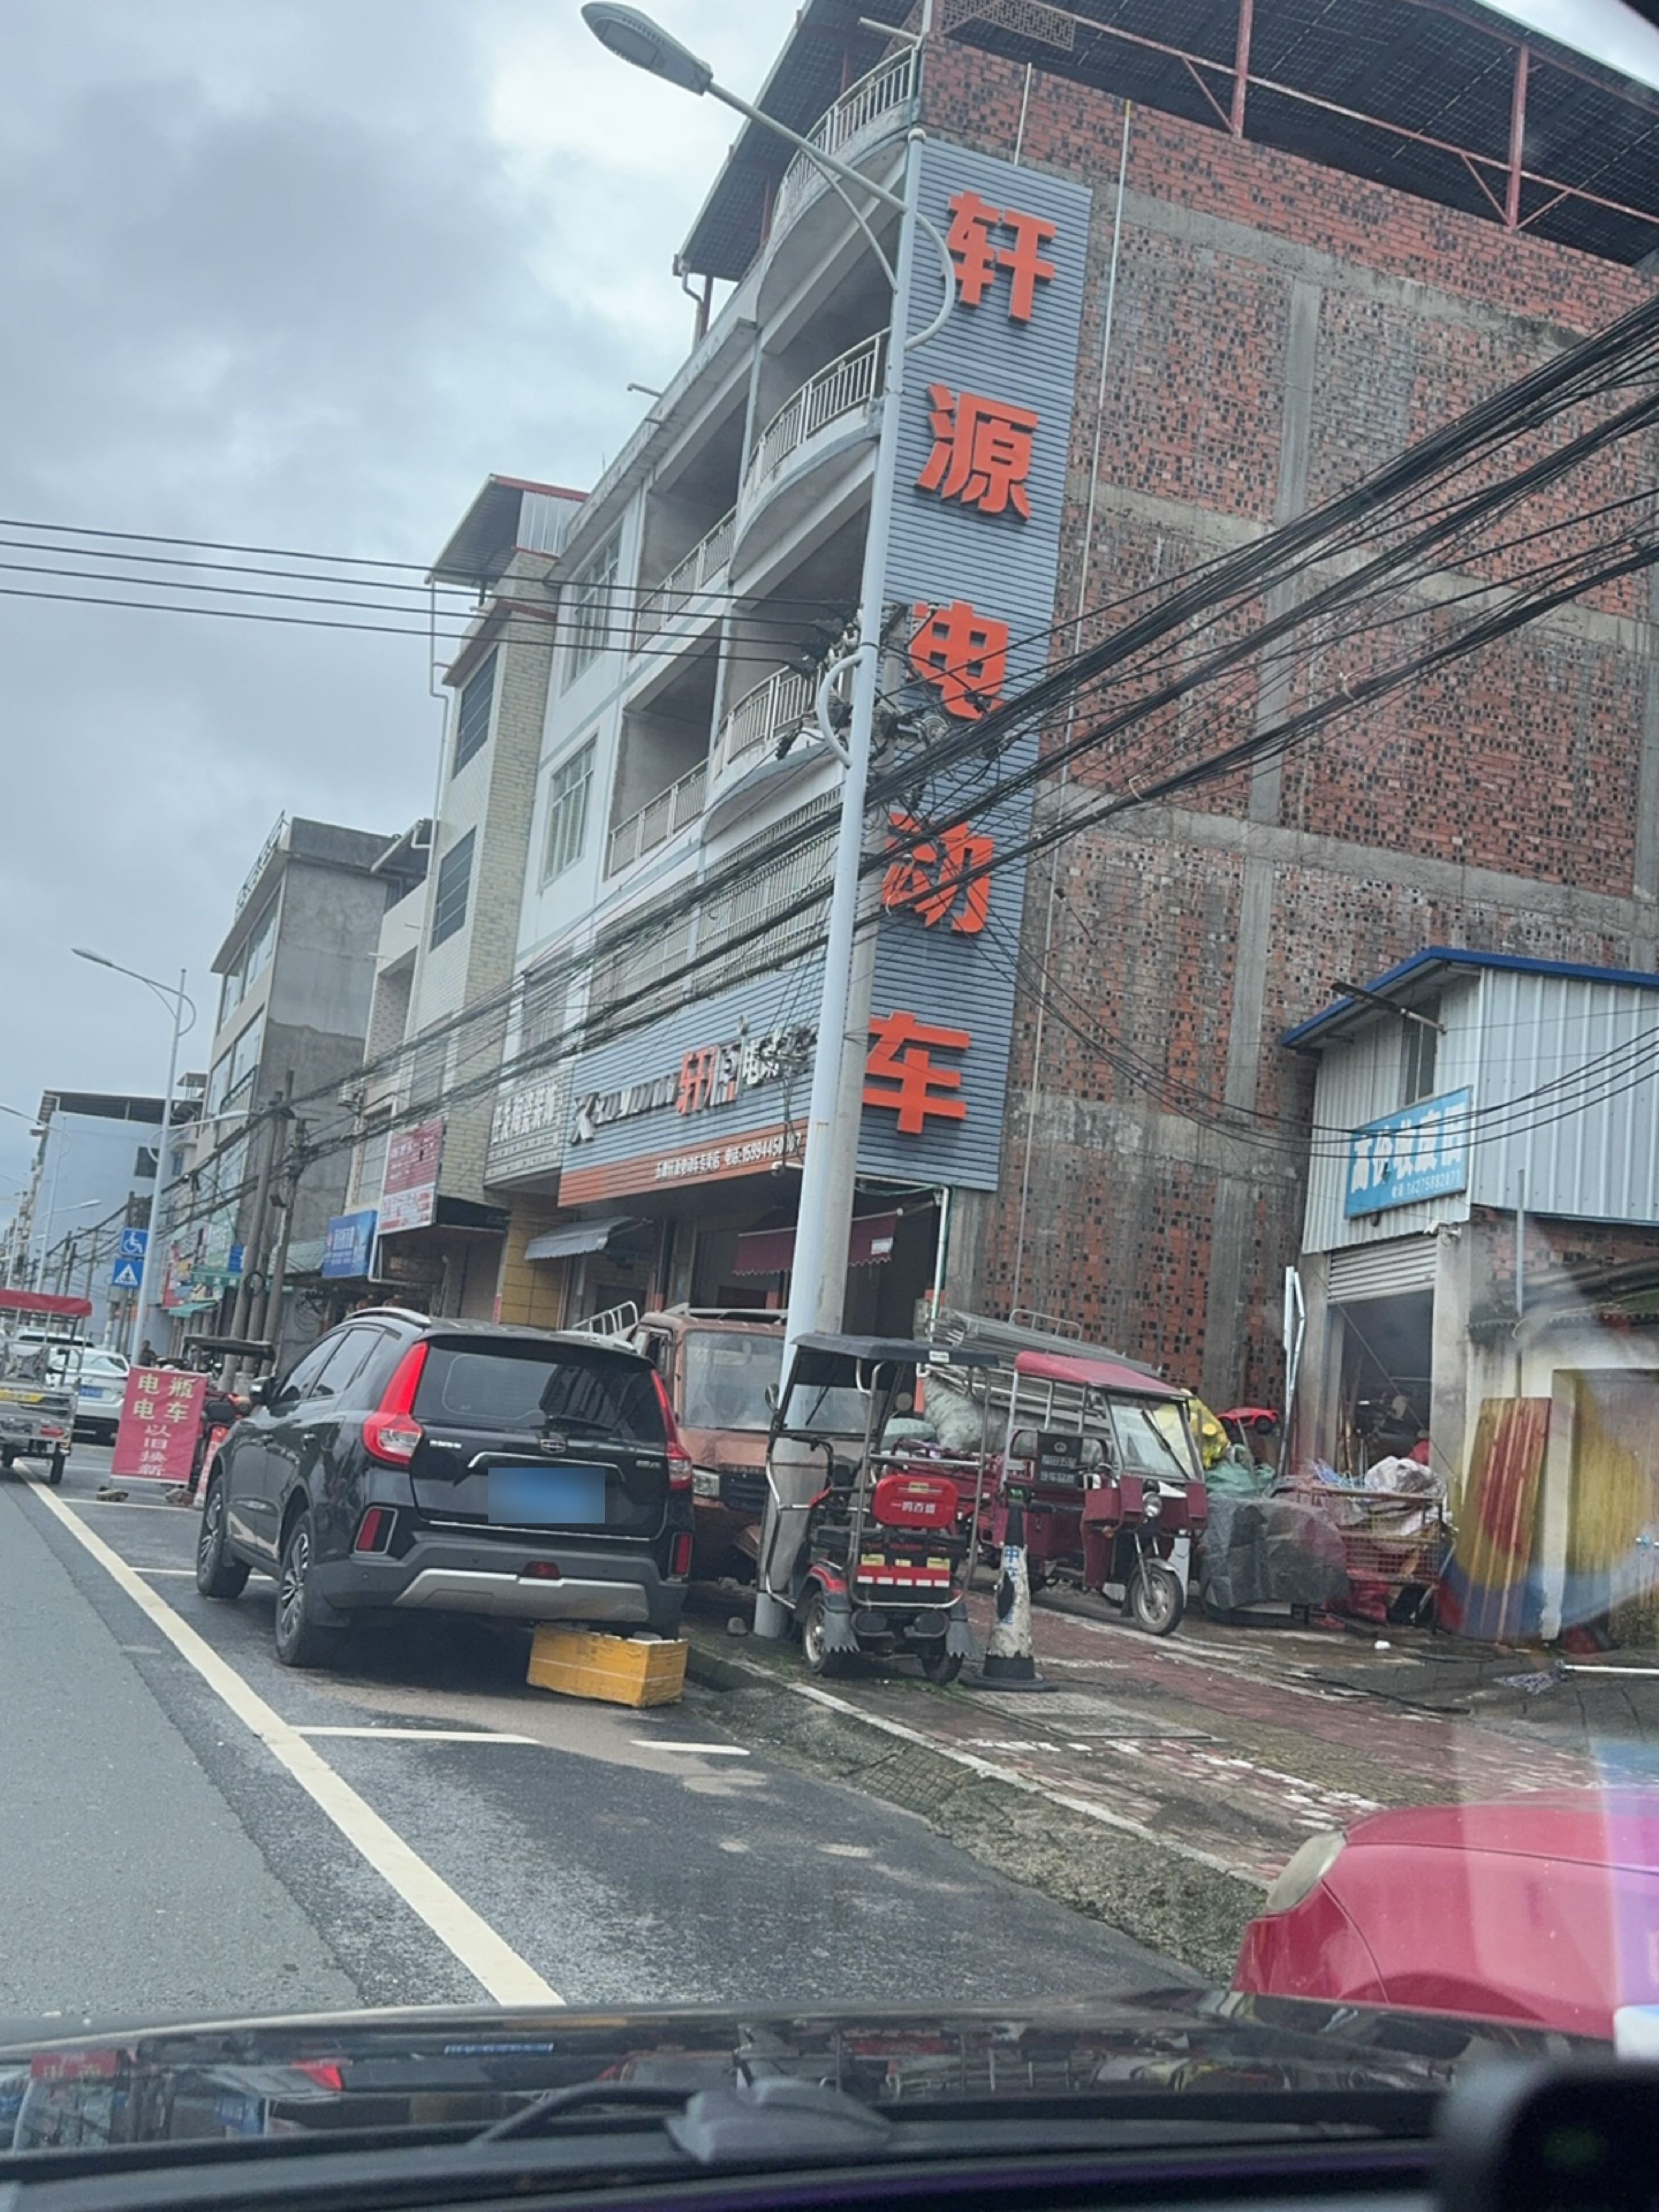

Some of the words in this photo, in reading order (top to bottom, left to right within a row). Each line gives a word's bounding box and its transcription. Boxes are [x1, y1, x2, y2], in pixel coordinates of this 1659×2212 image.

[863, 190, 1057, 1134] 轩源电动车
[138, 1373, 199, 1399] 电瓶
[132, 1397, 190, 1423] 电车
